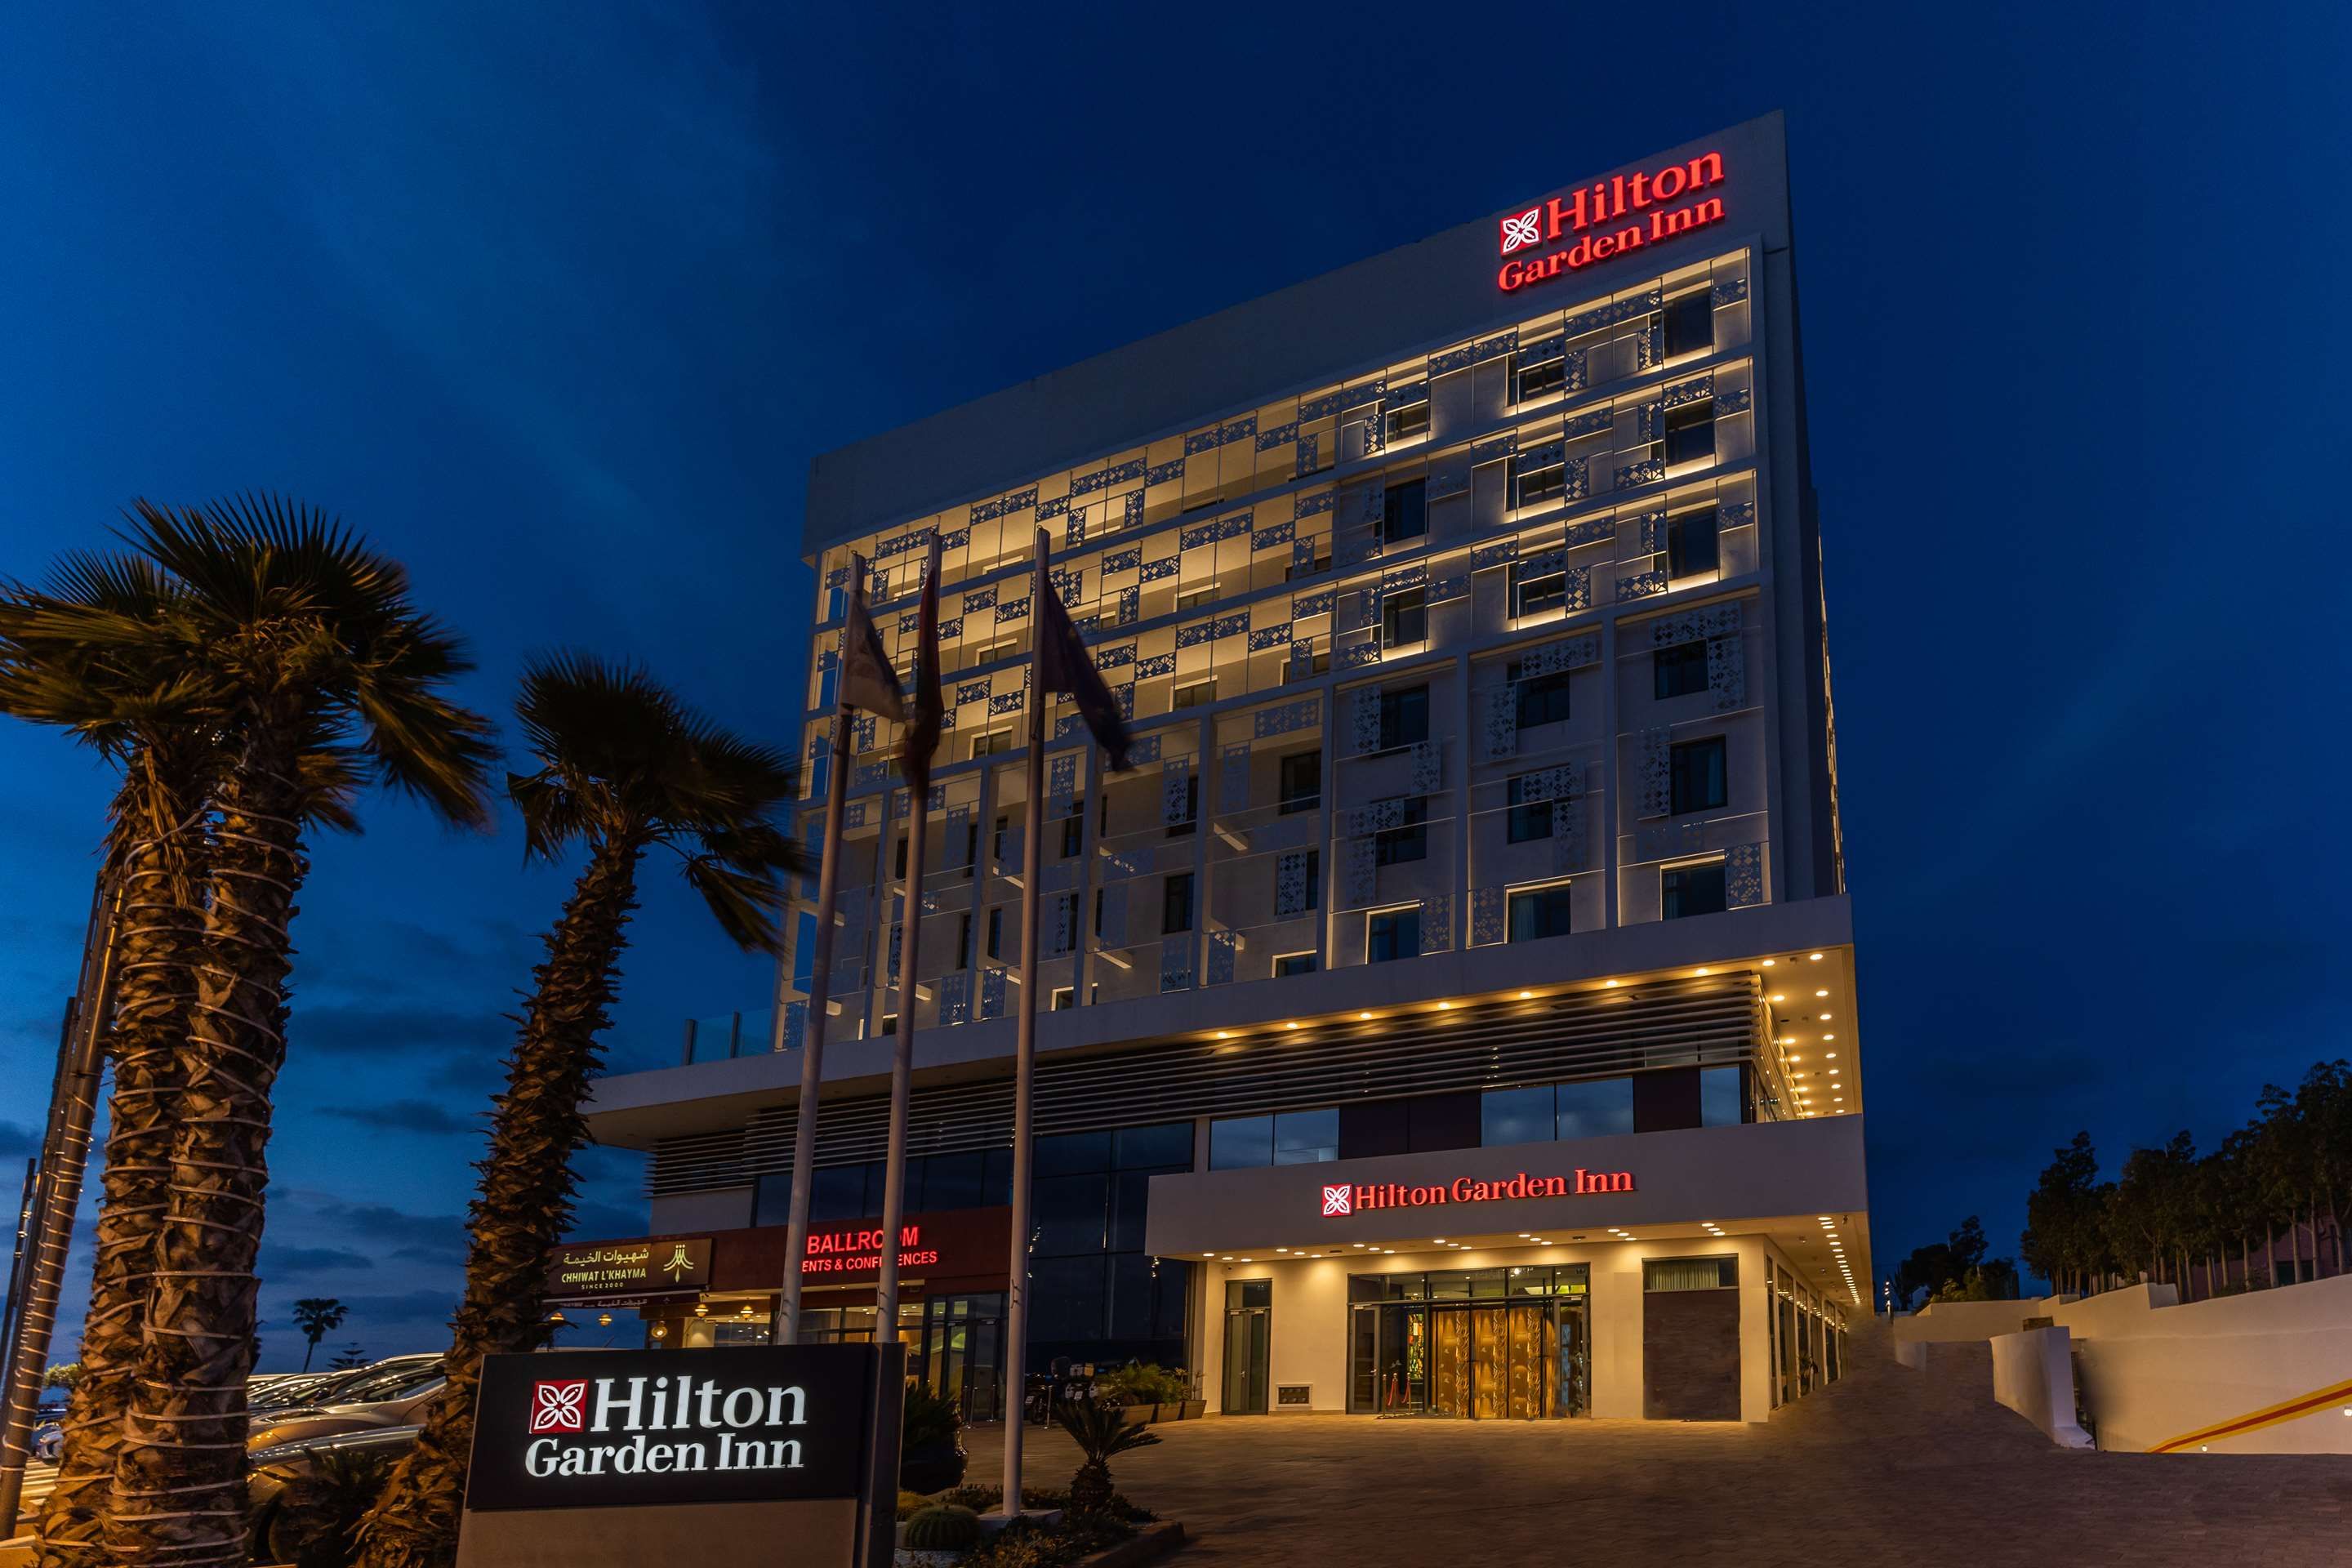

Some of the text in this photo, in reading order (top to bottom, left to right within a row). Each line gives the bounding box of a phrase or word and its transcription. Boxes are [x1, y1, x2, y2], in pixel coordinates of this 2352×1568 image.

[1547, 150, 1725, 239] Hilton
[1498, 197, 1725, 291] Garden Inn
[1356, 1169, 1634, 1209] Hilton Garden Inn
[807, 1227, 919, 1254] BALLROM
[835, 1258, 844, 1271] &
[846, 1251, 938, 1271] CONFENCES
[561, 1267, 647, 1283] CHHIWAT L'KHAYMA
[590, 1375, 808, 1432] Hilton
[524, 1432, 804, 1477] Garden Inn
